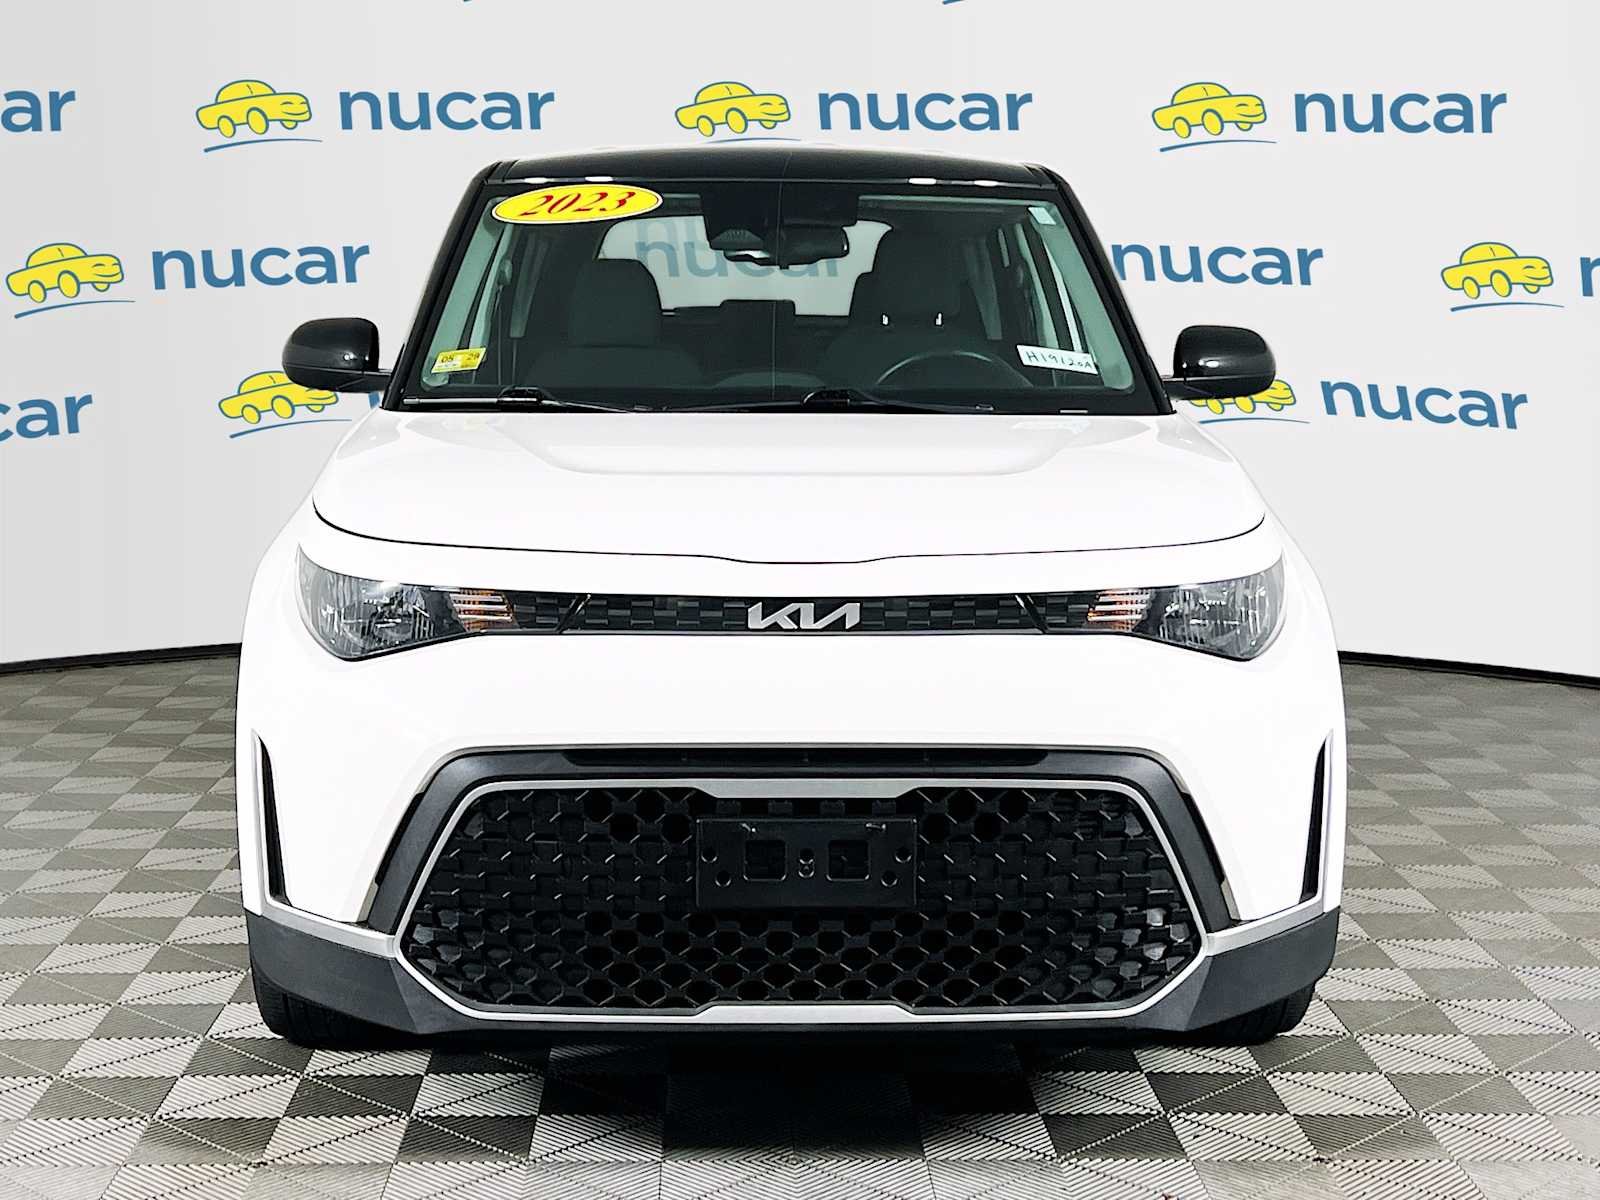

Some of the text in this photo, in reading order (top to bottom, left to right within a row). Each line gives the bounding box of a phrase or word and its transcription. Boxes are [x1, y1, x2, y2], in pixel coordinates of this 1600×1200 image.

[339, 90, 555, 132] nucar
[818, 91, 1033, 132] nucar
[1294, 92, 1508, 134] nucar
[517, 190, 636, 217] 2023
[152, 244, 370, 290] nucar
[1110, 243, 1324, 286] nucar
[1320, 379, 1529, 430] nucar
[747, 601, 861, 630] KIA
